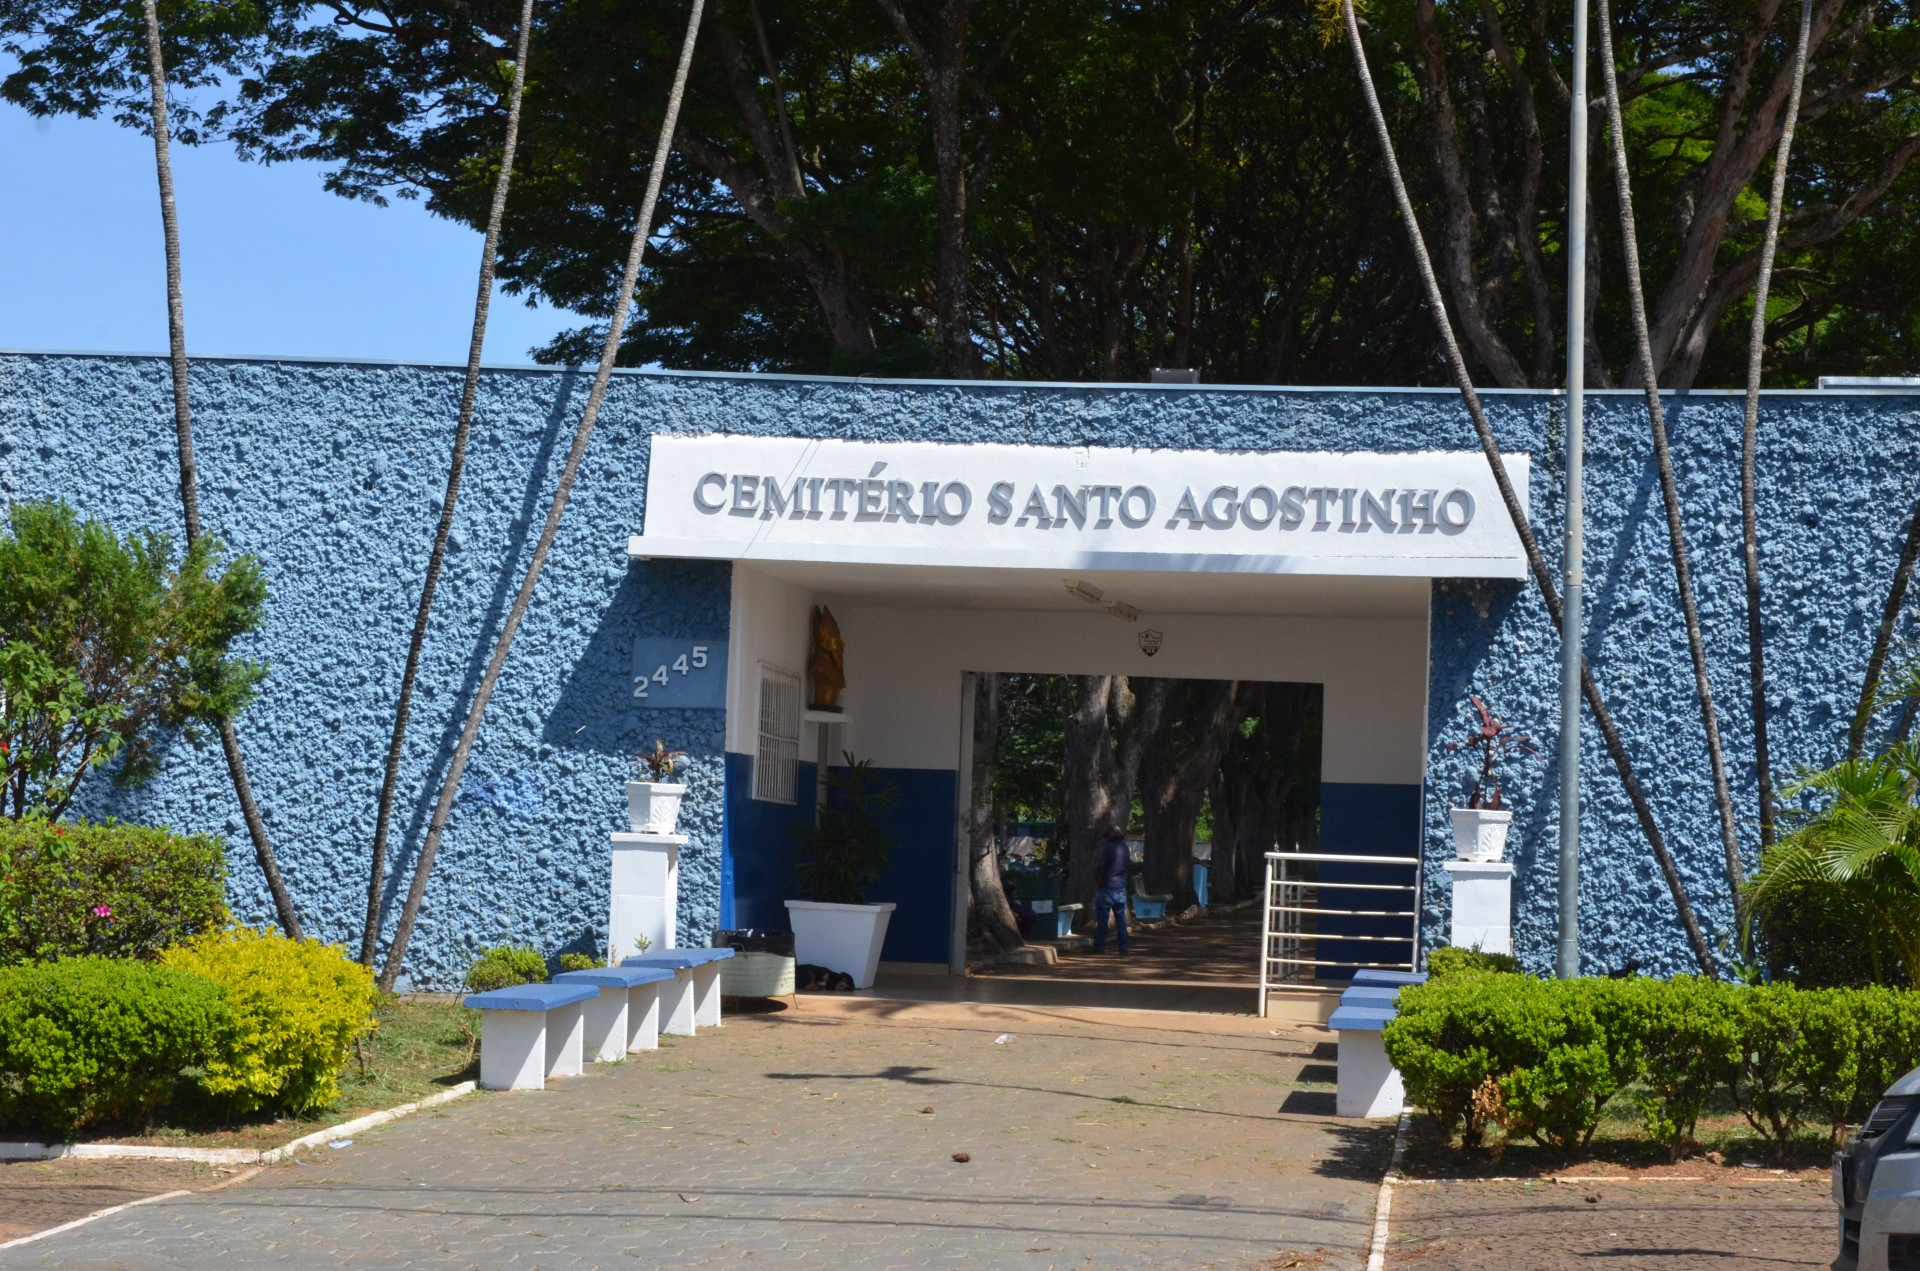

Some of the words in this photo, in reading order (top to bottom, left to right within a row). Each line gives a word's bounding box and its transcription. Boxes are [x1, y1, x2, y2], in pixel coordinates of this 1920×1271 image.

[695, 462, 972, 521] CEMITÉRIO
[990, 481, 1156, 526] SANTO
[1171, 485, 1476, 530] AGOSTINHO
[633, 646, 708, 698] 2445
